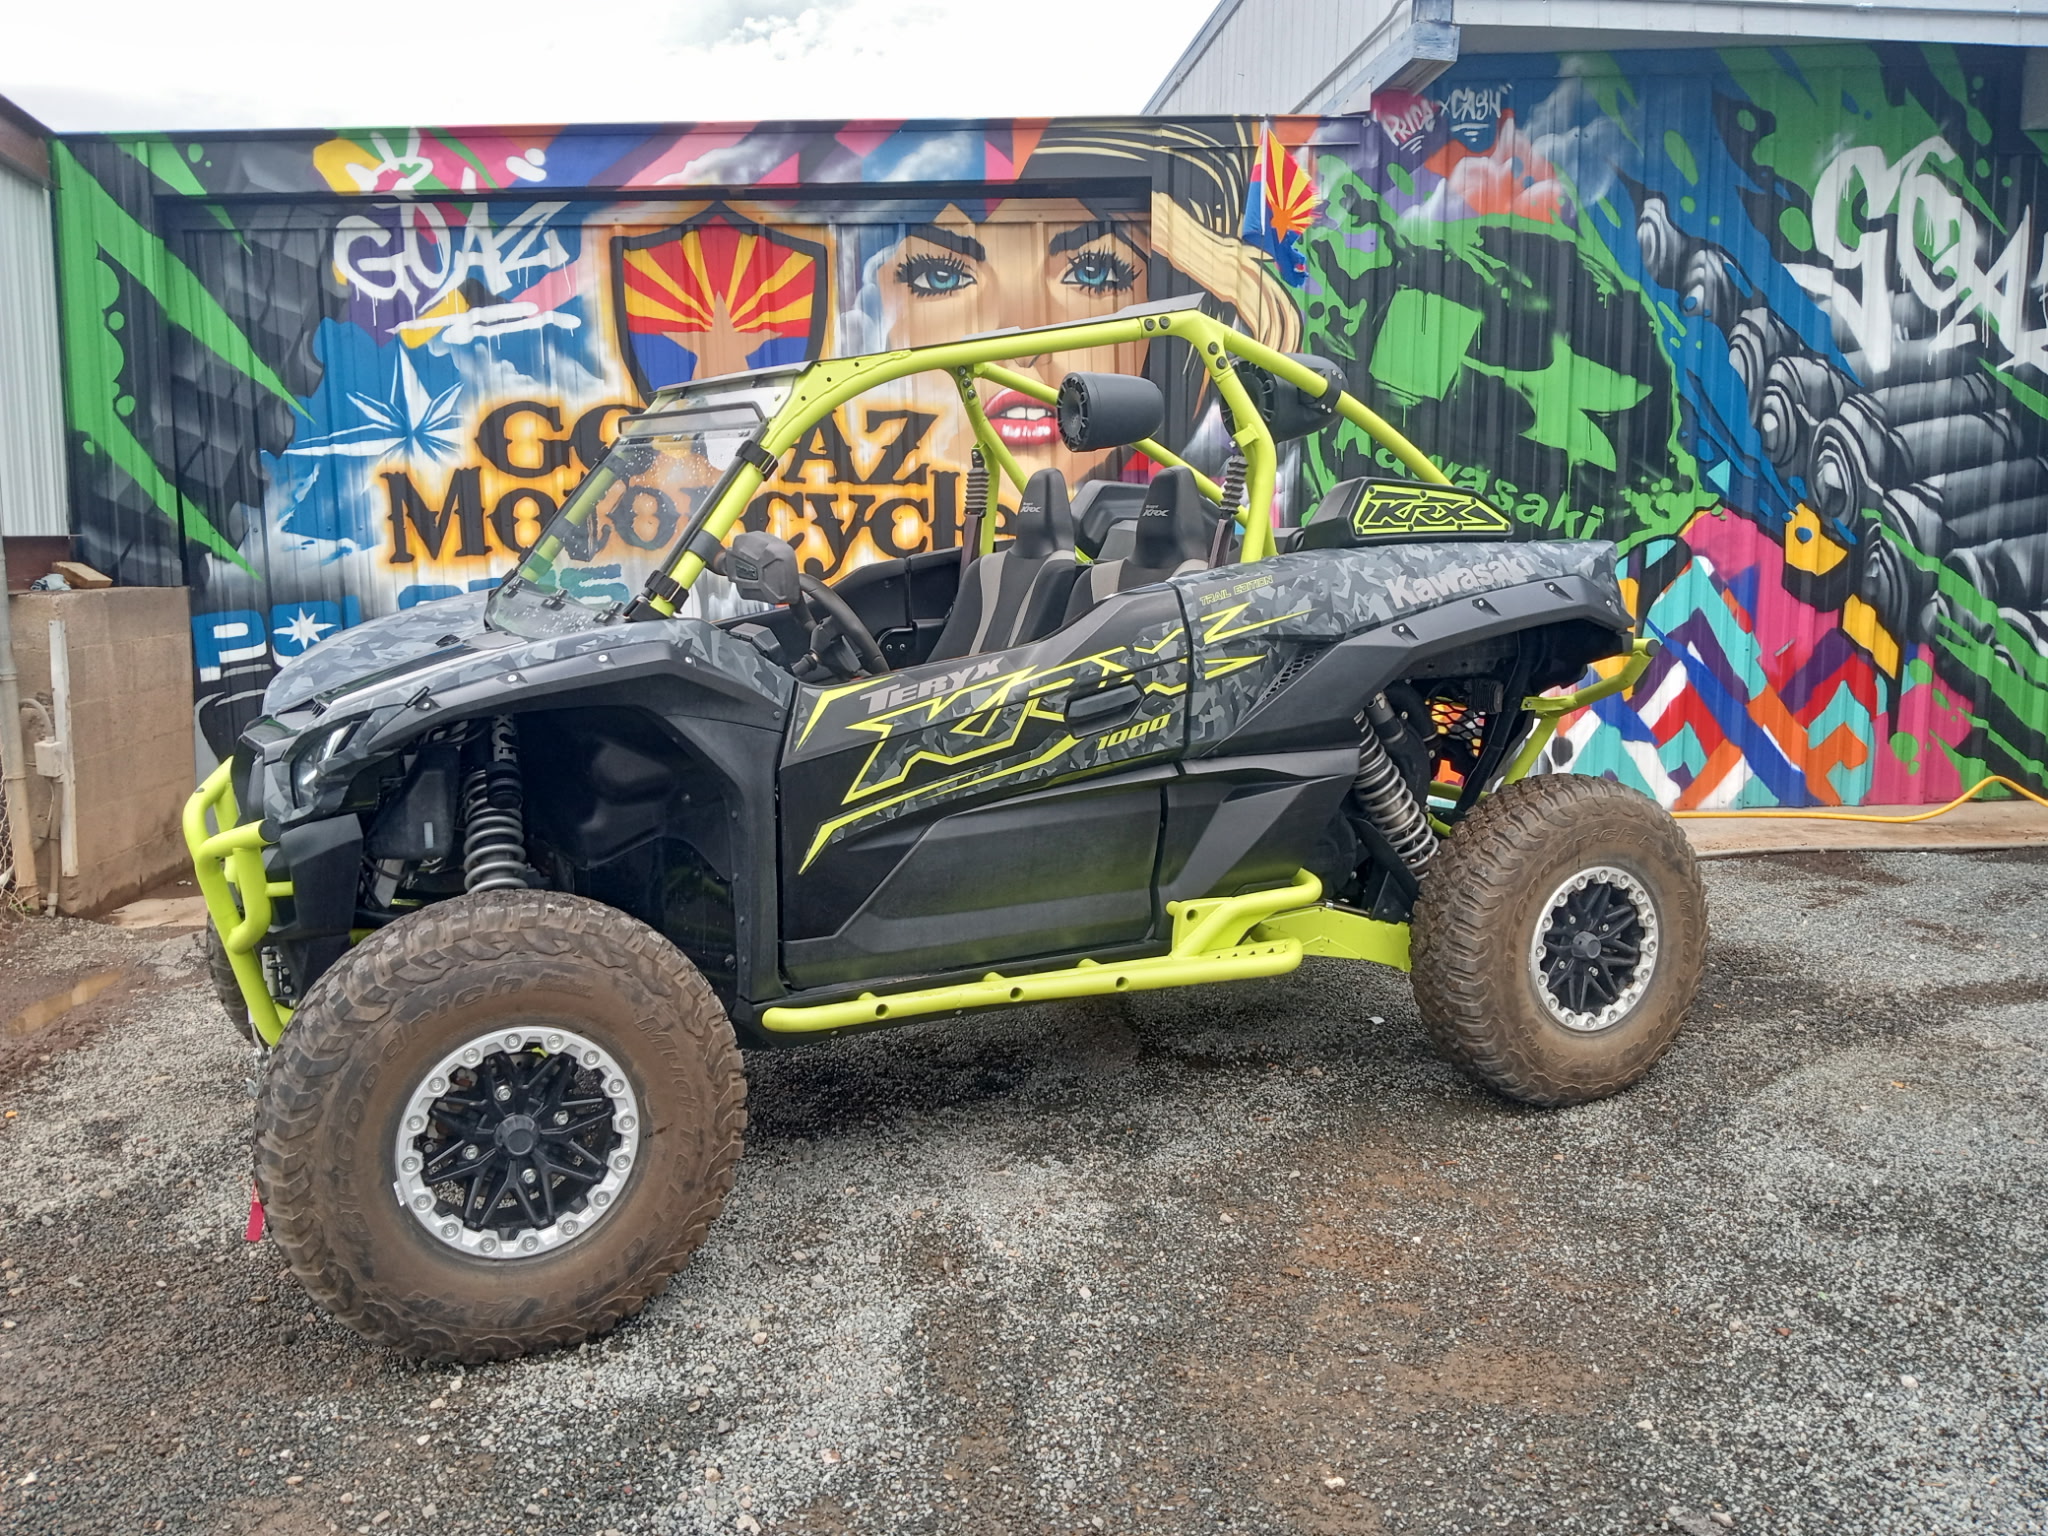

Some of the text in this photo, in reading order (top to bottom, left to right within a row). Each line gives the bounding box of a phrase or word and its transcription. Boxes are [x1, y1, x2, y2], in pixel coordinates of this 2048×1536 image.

[1142, 509, 1170, 517] KRX
[1368, 500, 1490, 526] KRX
[1199, 574, 1274, 606] TRAIL EDITION
[1384, 553, 1537, 610] Kawasaki
[859, 656, 1004, 715] TERYX
[1096, 713, 1172, 752] 1000
